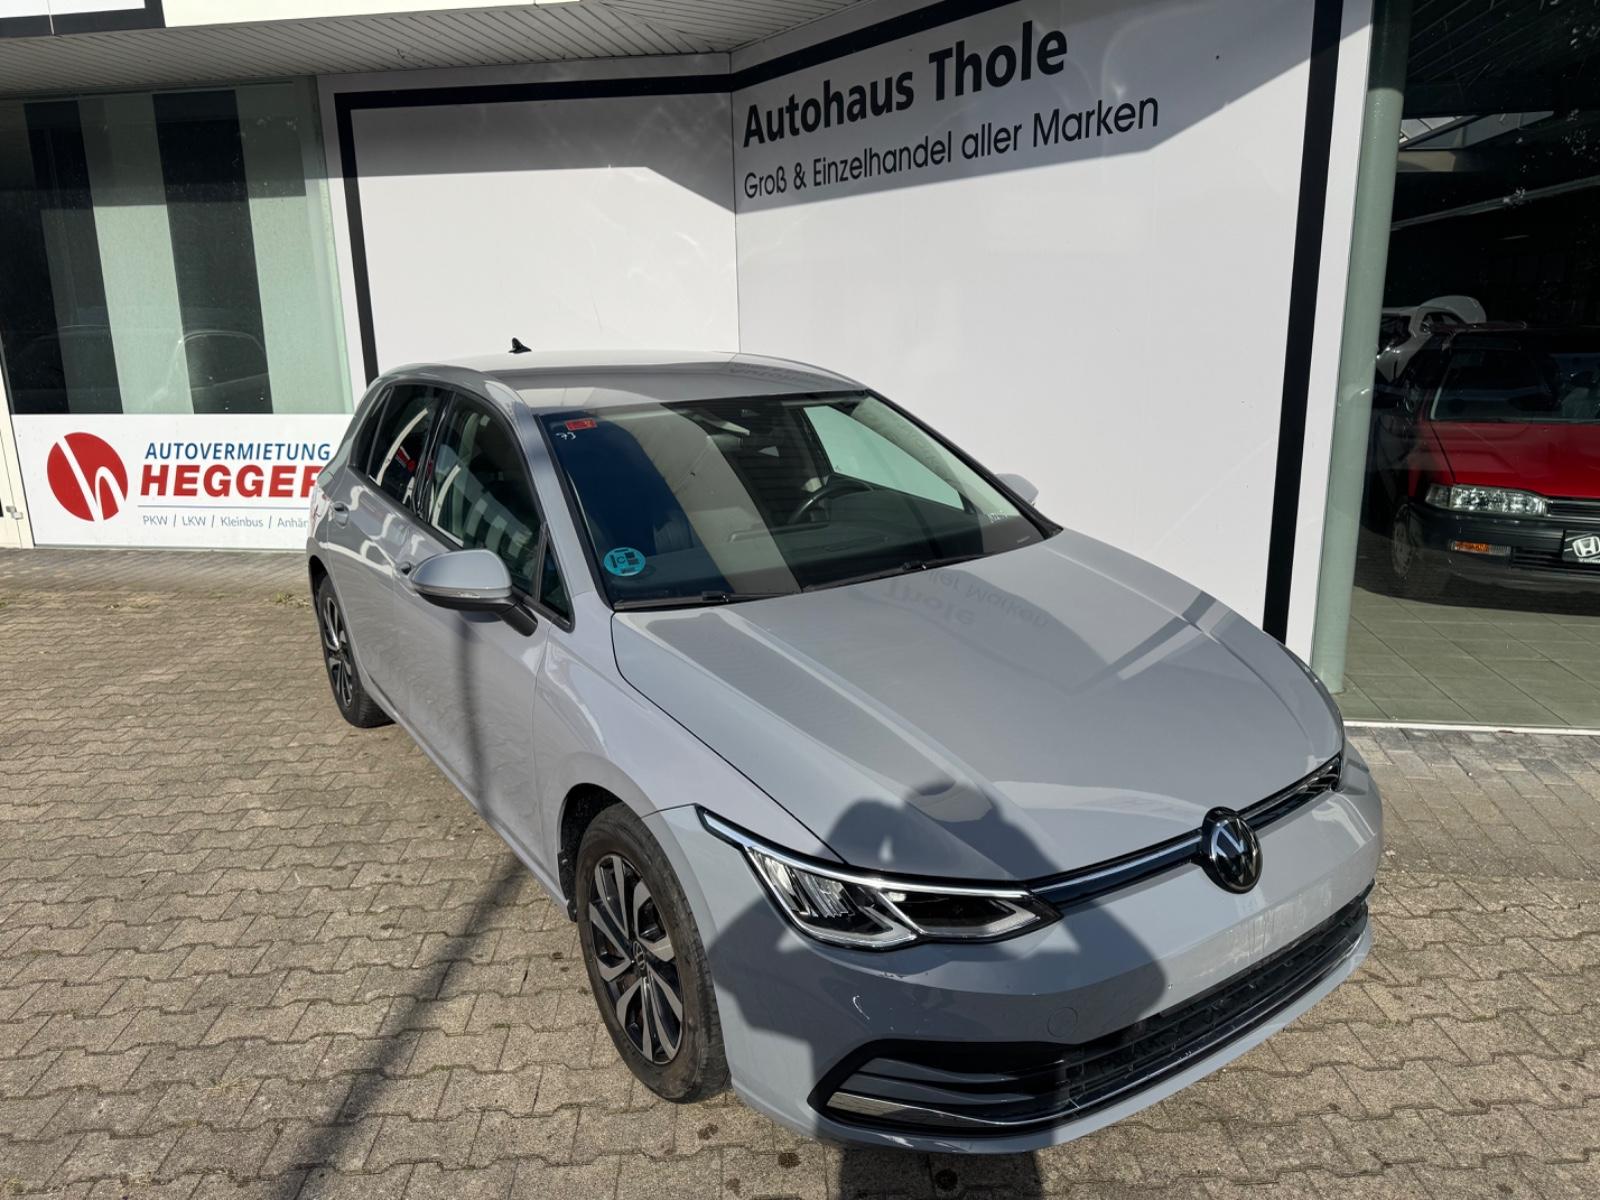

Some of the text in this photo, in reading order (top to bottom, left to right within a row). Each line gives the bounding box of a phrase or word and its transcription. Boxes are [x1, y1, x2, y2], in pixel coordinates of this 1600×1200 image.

[743, 20, 1067, 148] Autohaus Thole
[744, 97, 1158, 199] Groß & Einzelhandel aller Marken
[145, 442, 331, 461] AUTOVERMIETUNG
[142, 515, 168, 526] PKW
[181, 516, 206, 527] LKW
[220, 516, 264, 528] Kleinbus
